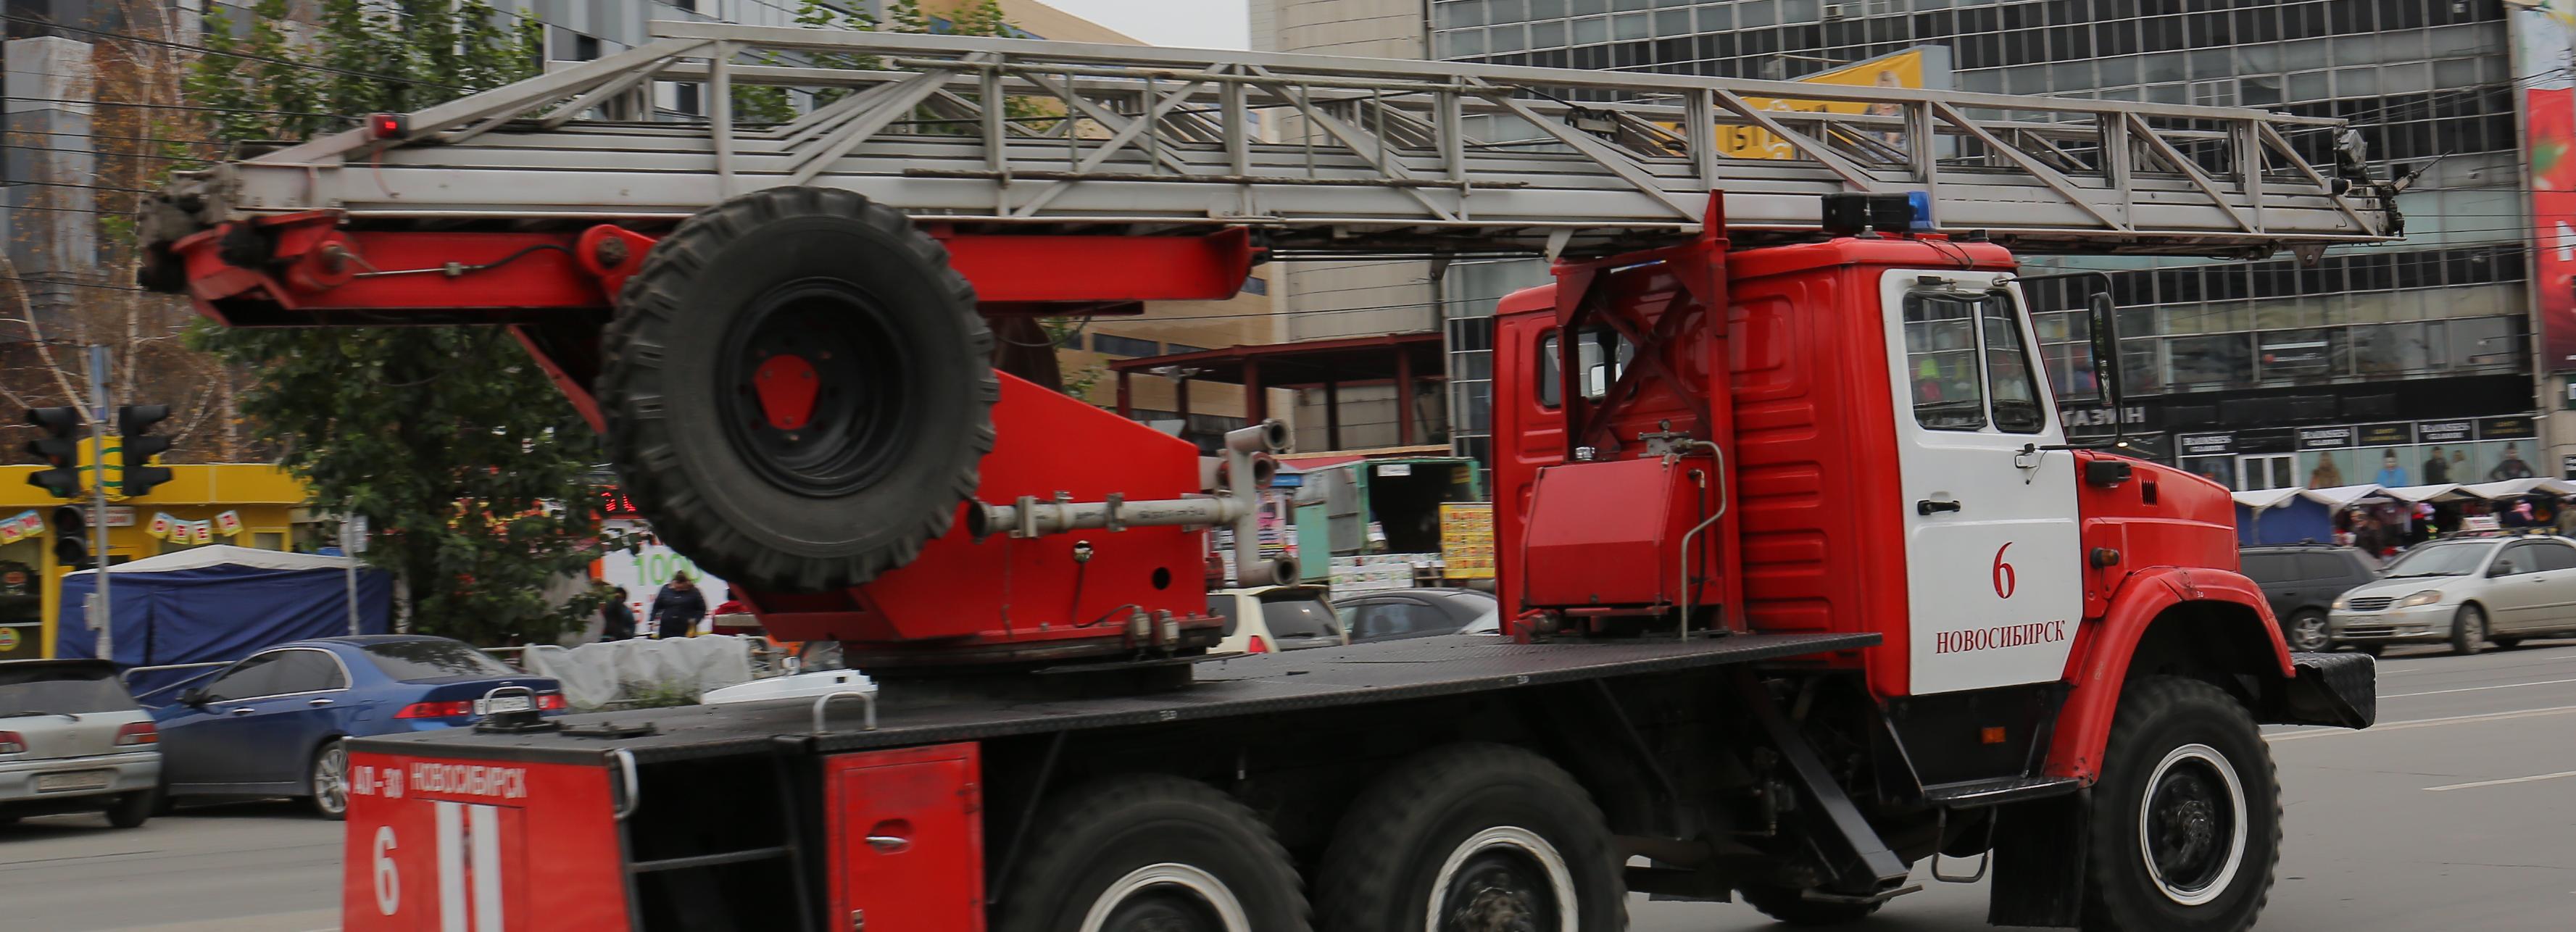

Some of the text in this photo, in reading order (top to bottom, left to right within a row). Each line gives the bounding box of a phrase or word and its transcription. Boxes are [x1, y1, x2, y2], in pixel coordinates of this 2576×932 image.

[1993, 541, 2015, 599] 6
[1935, 620, 2065, 654] НОВОСИБИРСК
[410, 762, 527, 799] НОВОСИБИРСК
[373, 825, 400, 916] 6
